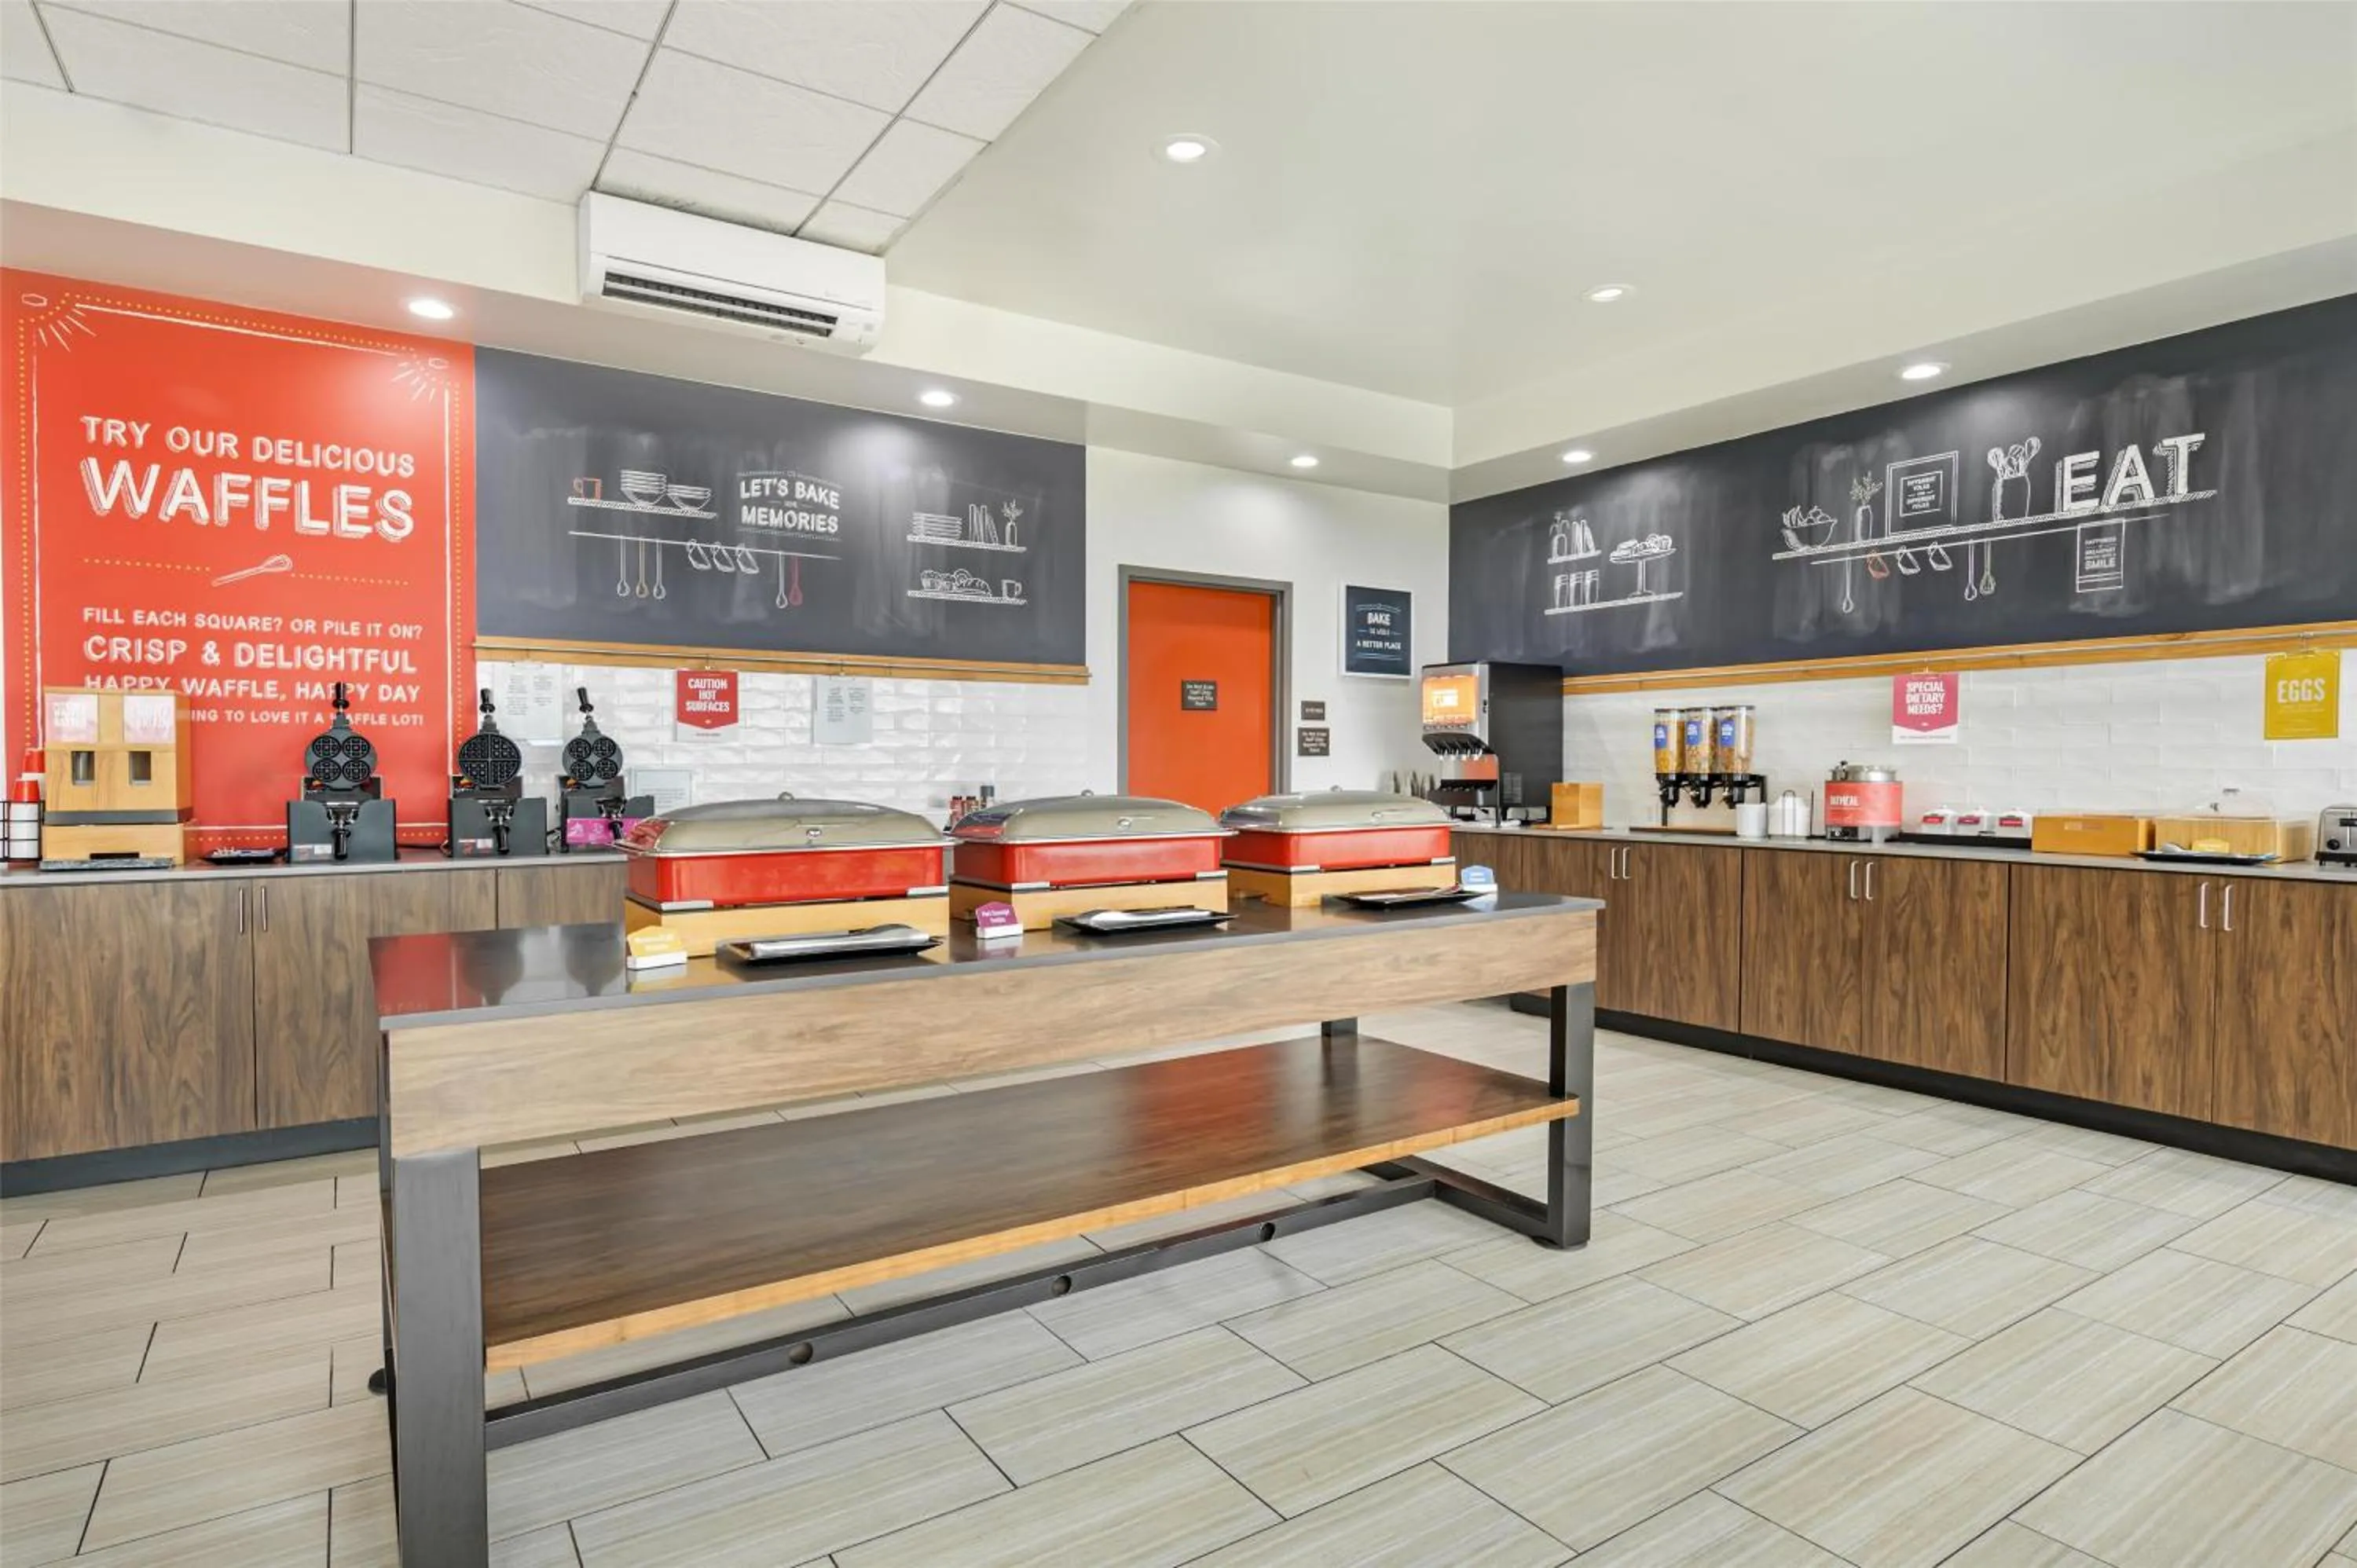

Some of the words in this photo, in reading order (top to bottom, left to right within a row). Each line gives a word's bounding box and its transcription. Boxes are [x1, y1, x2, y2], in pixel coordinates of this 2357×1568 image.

[80, 416, 151, 449] TRY
[166, 427, 239, 459] OUR
[252, 436, 415, 478] DELICIOUS
[2055, 433, 2205, 513] EAT
[80, 456, 414, 543] WAFFLES
[740, 478, 788, 499] LET'S
[795, 482, 840, 509] BAKE
[742, 505, 839, 533] MEMORIES
[2084, 557, 2116, 570] SMILE
[83, 607, 125, 625] FILL
[133, 610, 186, 628] EACH
[194, 613, 283, 633] SQUARE?
[290, 618, 317, 634] OR
[323, 621, 361, 637] PILE
[367, 623, 383, 637] IT
[388, 625, 423, 640] ON?
[1367, 612, 1391, 626] BAKE
[83, 635, 187, 665] CRISP
[201, 640, 221, 667] &
[234, 641, 417, 675] DELIGHTFUL
[84, 673, 171, 691] HAPPY
[181, 677, 287, 702] WAFFLE,
[378, 683, 420, 703] DAY
[687, 678, 729, 690] CAUTION
[1906, 680, 1945, 692] SPECIAL
[2277, 677, 2326, 704] EGGS
[698, 690, 717, 701] HOT
[1905, 692, 1946, 704] DIETARY
[191, 709, 218, 721] ING
[225, 711, 244, 721] TO
[251, 711, 290, 724] LOVE
[295, 712, 309, 724] IT
[313, 713, 324, 724] A
[685, 701, 730, 713] SURFACES
[1907, 703, 1944, 715] NEEDS?
